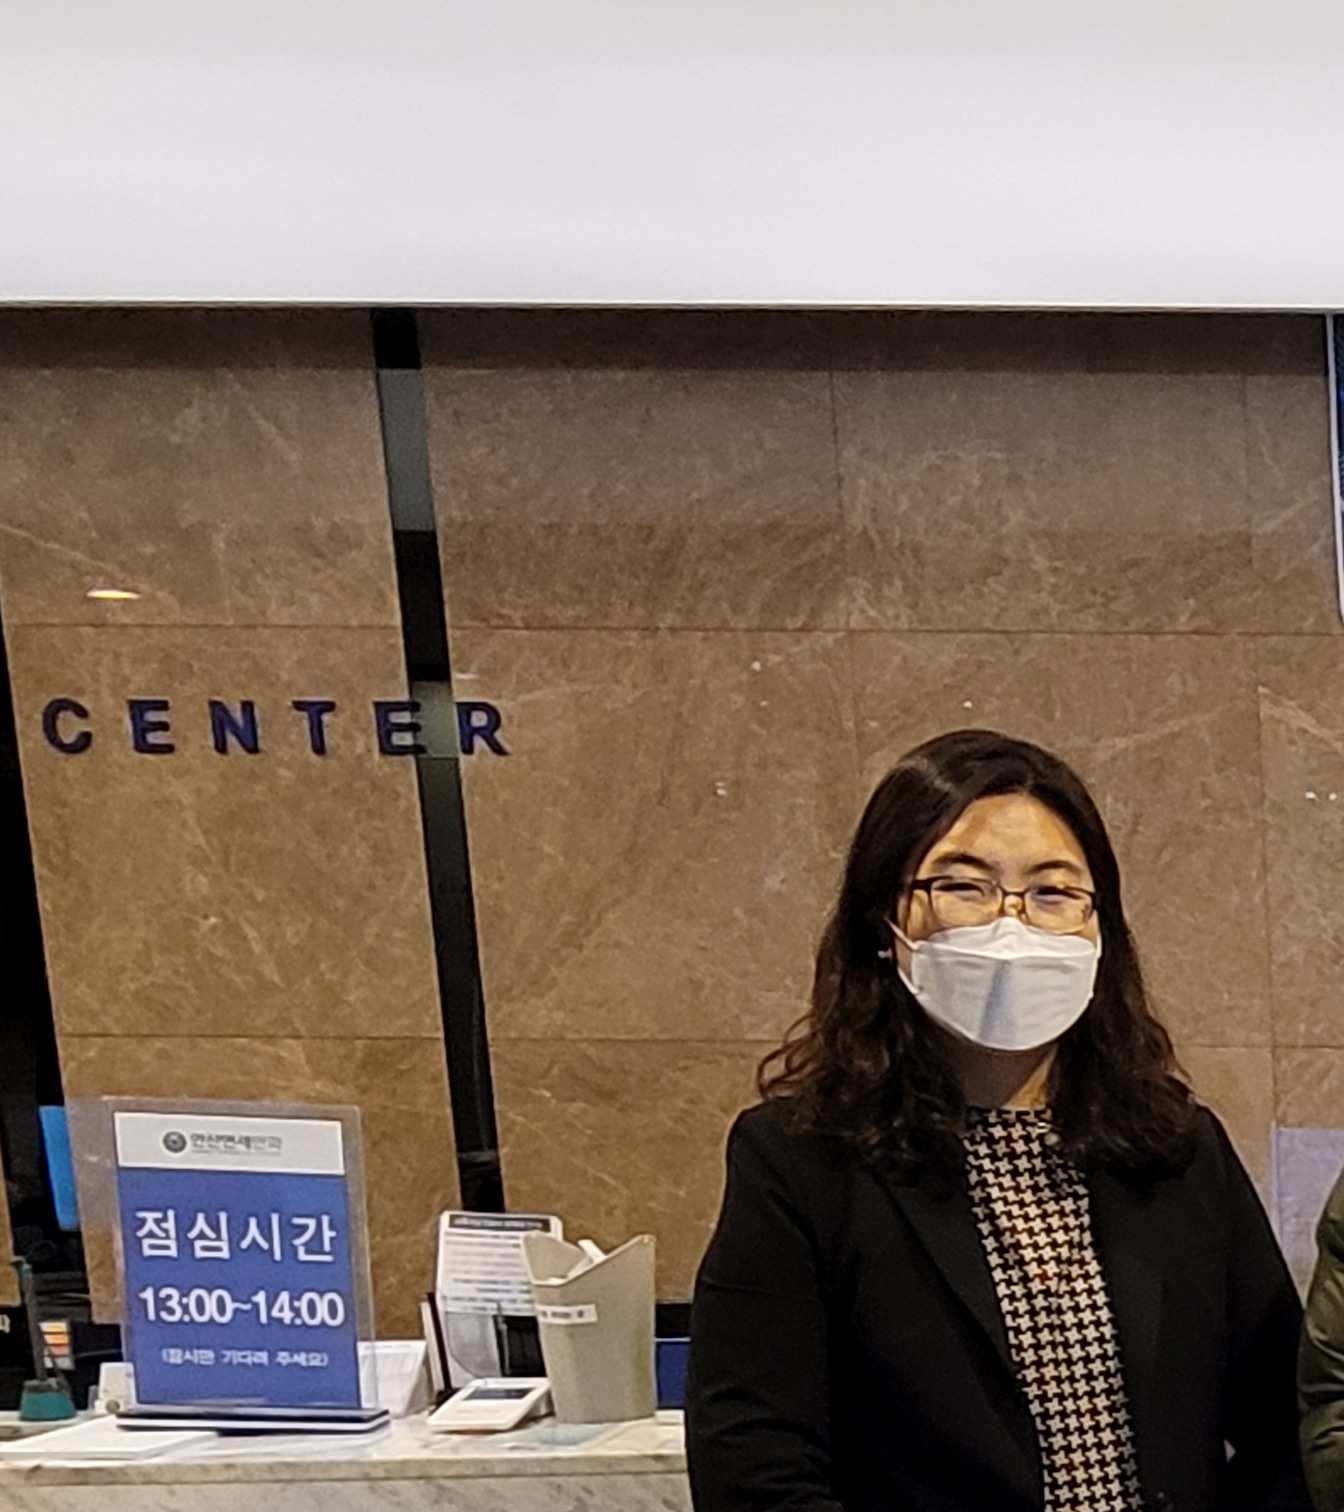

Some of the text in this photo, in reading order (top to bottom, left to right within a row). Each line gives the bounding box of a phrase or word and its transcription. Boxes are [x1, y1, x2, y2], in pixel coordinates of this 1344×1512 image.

[42, 698, 509, 755] CENTER
[135, 1208, 338, 1262] 점심시간
[138, 1286, 345, 1327] 13:00~14:00
[221, 1349, 270, 1367] 기다려
